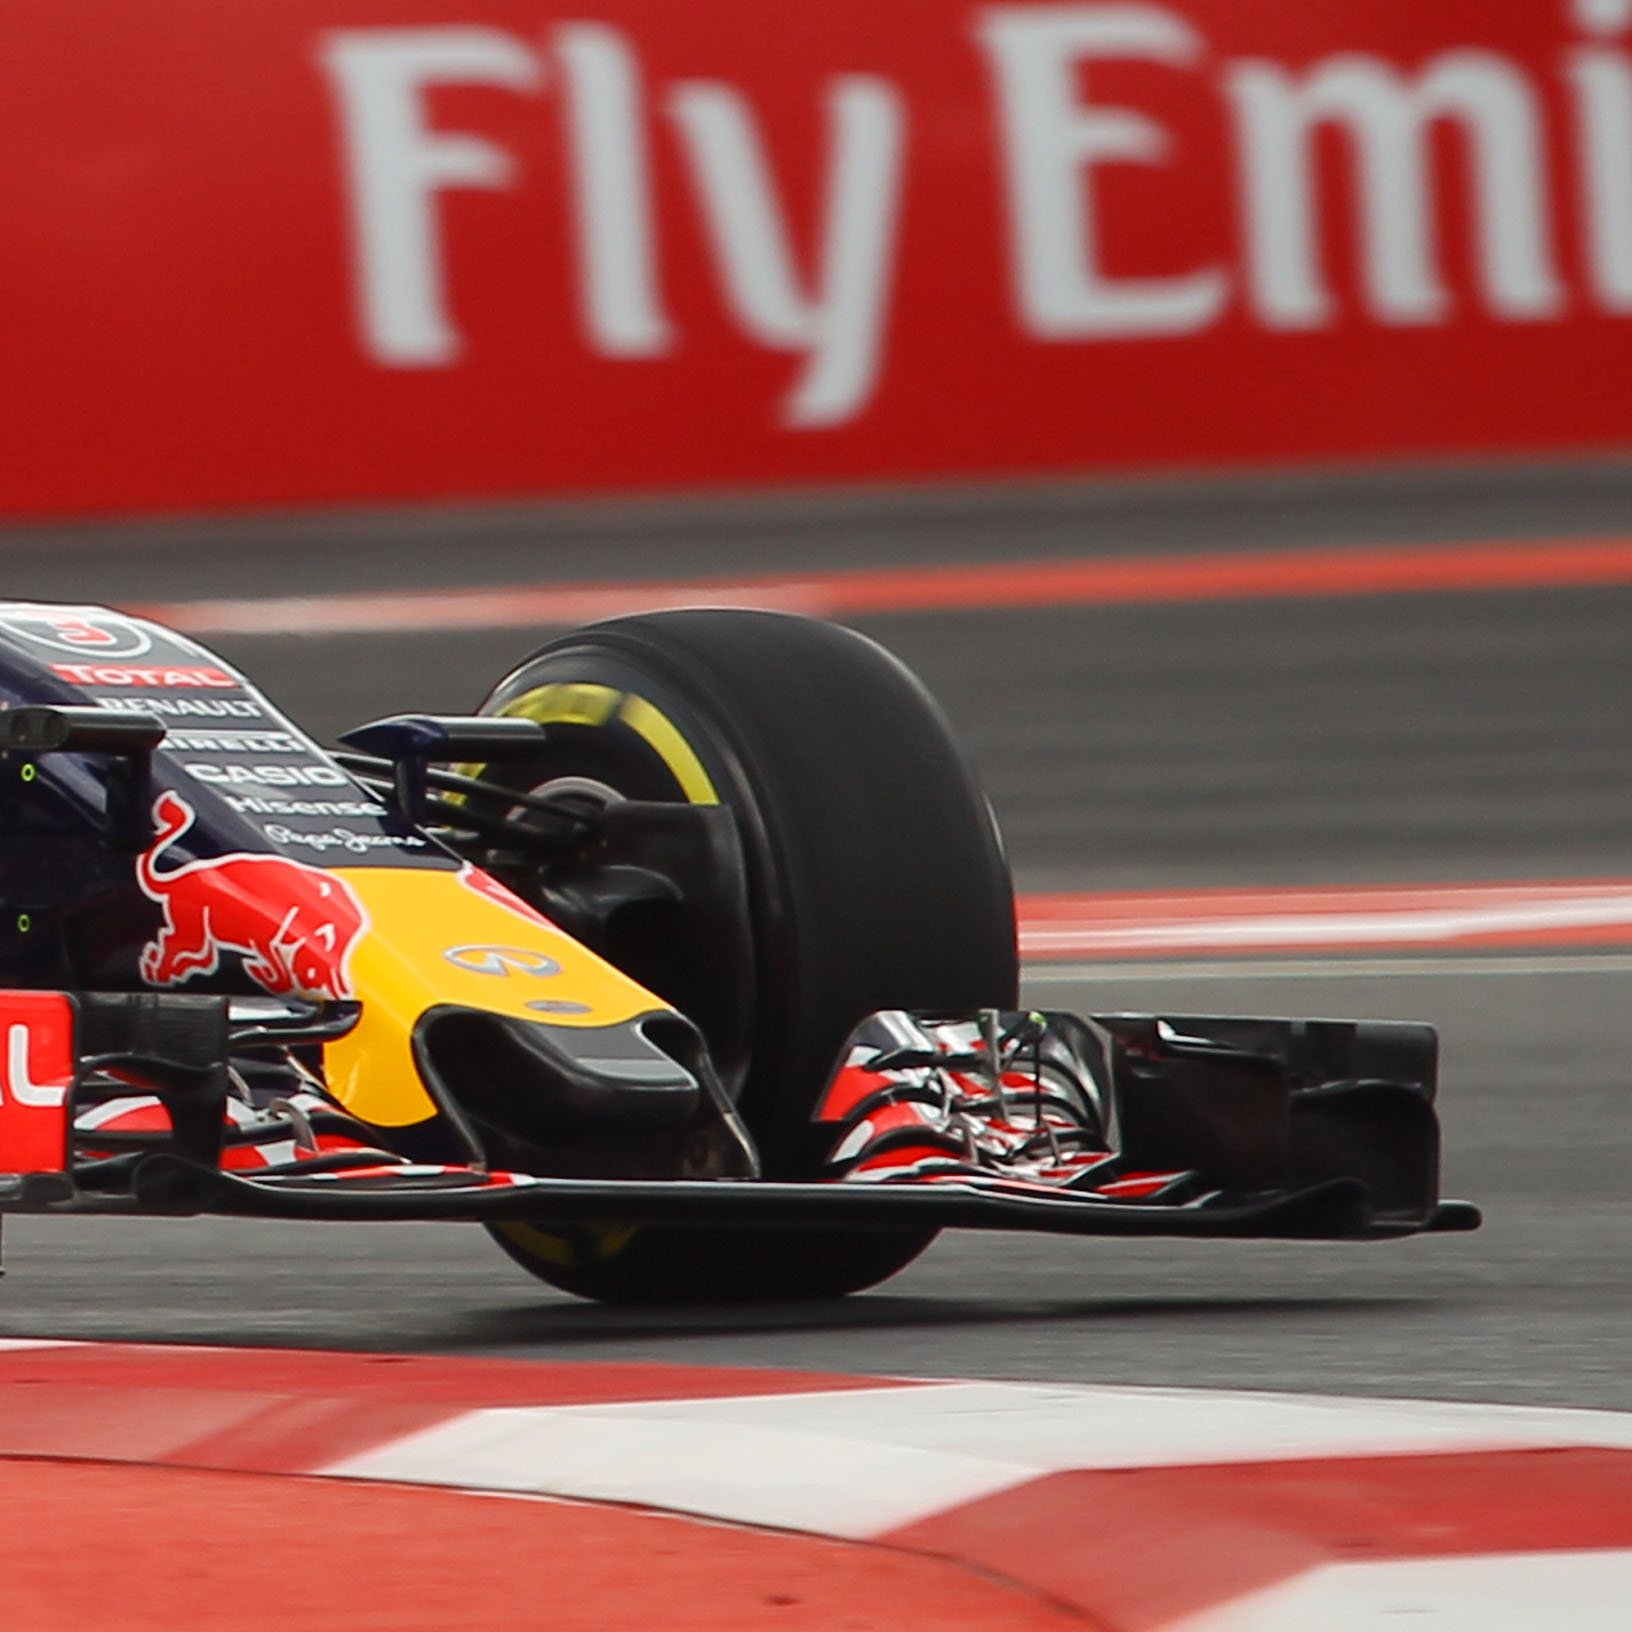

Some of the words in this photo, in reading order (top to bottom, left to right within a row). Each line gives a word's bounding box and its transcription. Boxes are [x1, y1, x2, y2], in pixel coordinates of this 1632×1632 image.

[316, 18, 906, 432] Fly
[51, 664, 238, 688] TOTAL
[96, 697, 264, 718] RENAULT
[183, 763, 349, 787] CASIO
[224, 795, 388, 817] Hisense
[262, 824, 340, 850] Pepe
[334, 827, 427, 853] Jeans
